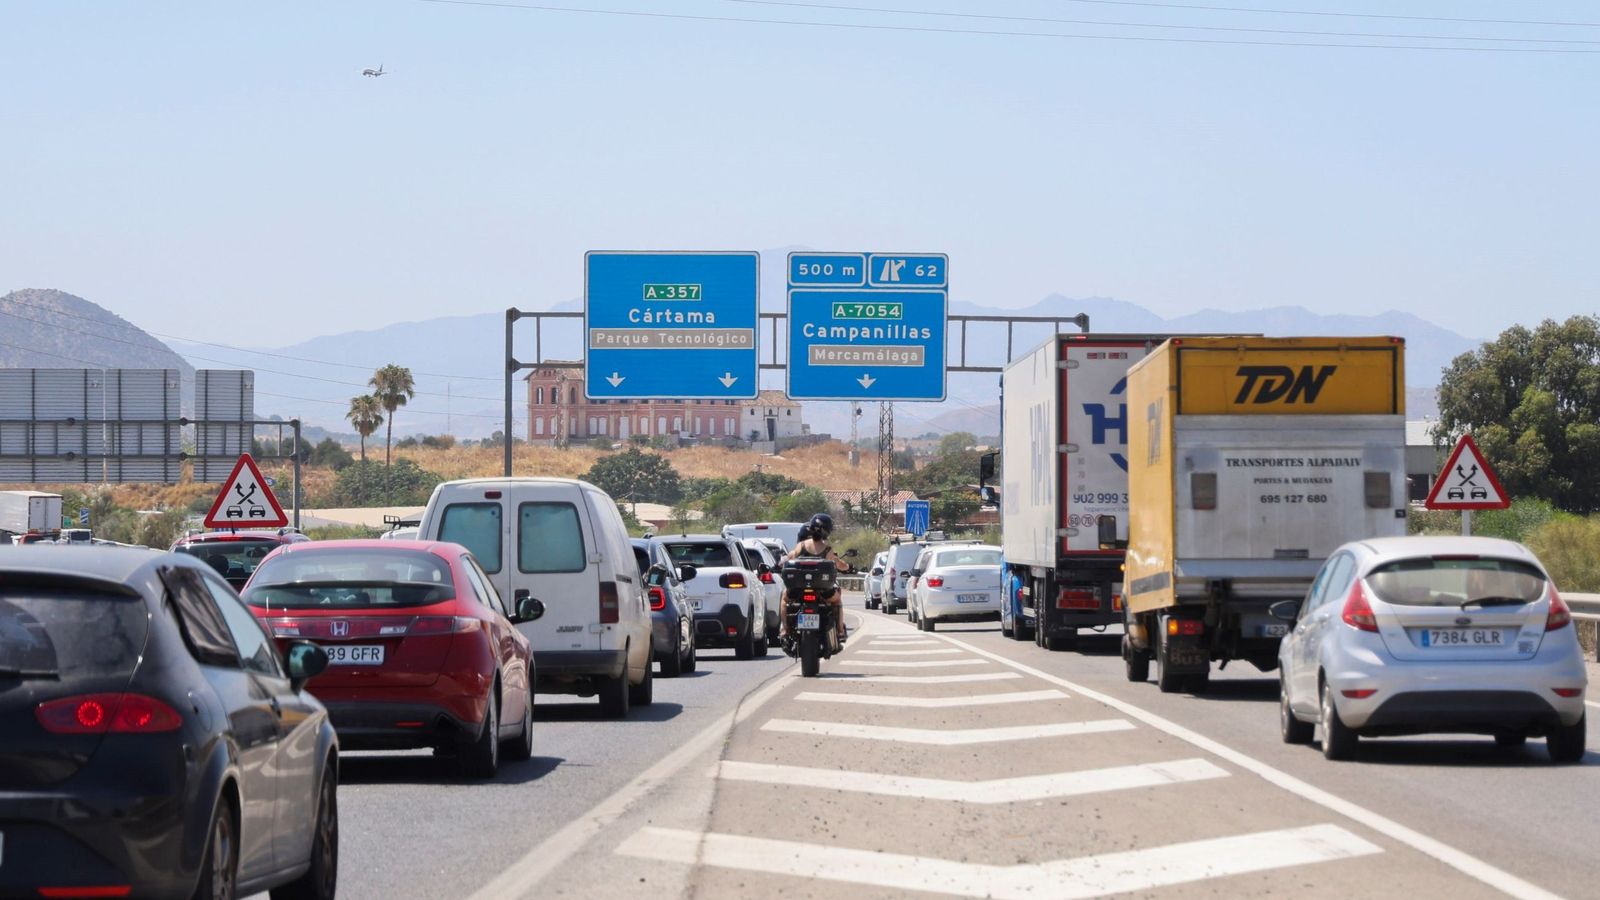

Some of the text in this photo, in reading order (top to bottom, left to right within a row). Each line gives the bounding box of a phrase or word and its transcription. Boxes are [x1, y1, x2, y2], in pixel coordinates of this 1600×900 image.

[799, 263, 856, 276] 500 m
[915, 265, 937, 277] 62
[645, 286, 699, 299] A-357
[628, 308, 716, 324] Cártama
[834, 304, 901, 317] A-7054
[802, 322, 932, 341] Campanillas
[596, 332, 747, 346] Parque Tecnológico
[814, 349, 919, 363] Mercamálaga
[1234, 365, 1338, 404] TDN
[1226, 457, 1304, 468] TRANSPORTES
[1096, 493, 1119, 504] 999
[1260, 494, 1328, 503] 695 127 680
[1431, 630, 1500, 644] 7384 GLR
[351, 647, 380, 661] GFR
